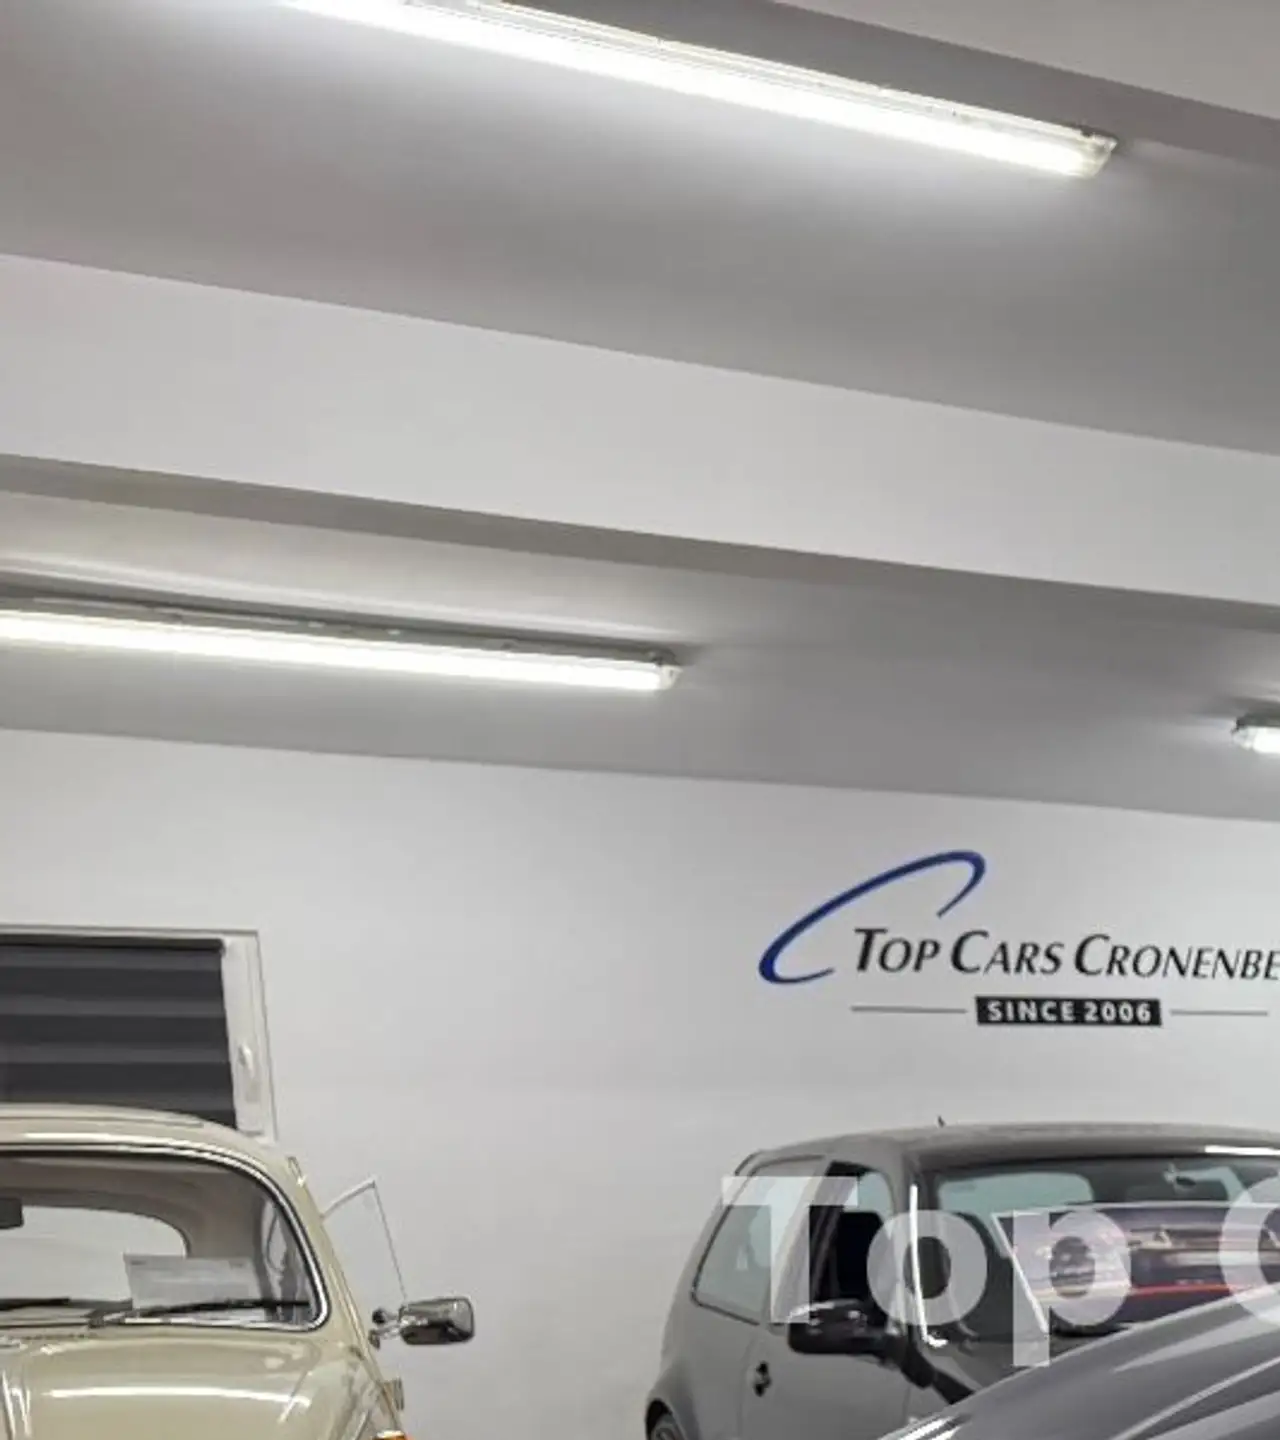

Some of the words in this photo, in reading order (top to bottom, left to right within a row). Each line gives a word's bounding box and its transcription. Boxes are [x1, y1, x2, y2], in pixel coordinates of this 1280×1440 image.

[853, 927, 940, 973] TOP
[949, 929, 1062, 976] CARS
[985, 1001, 1076, 1023] SINCE
[1083, 1003, 1154, 1024] 2006
